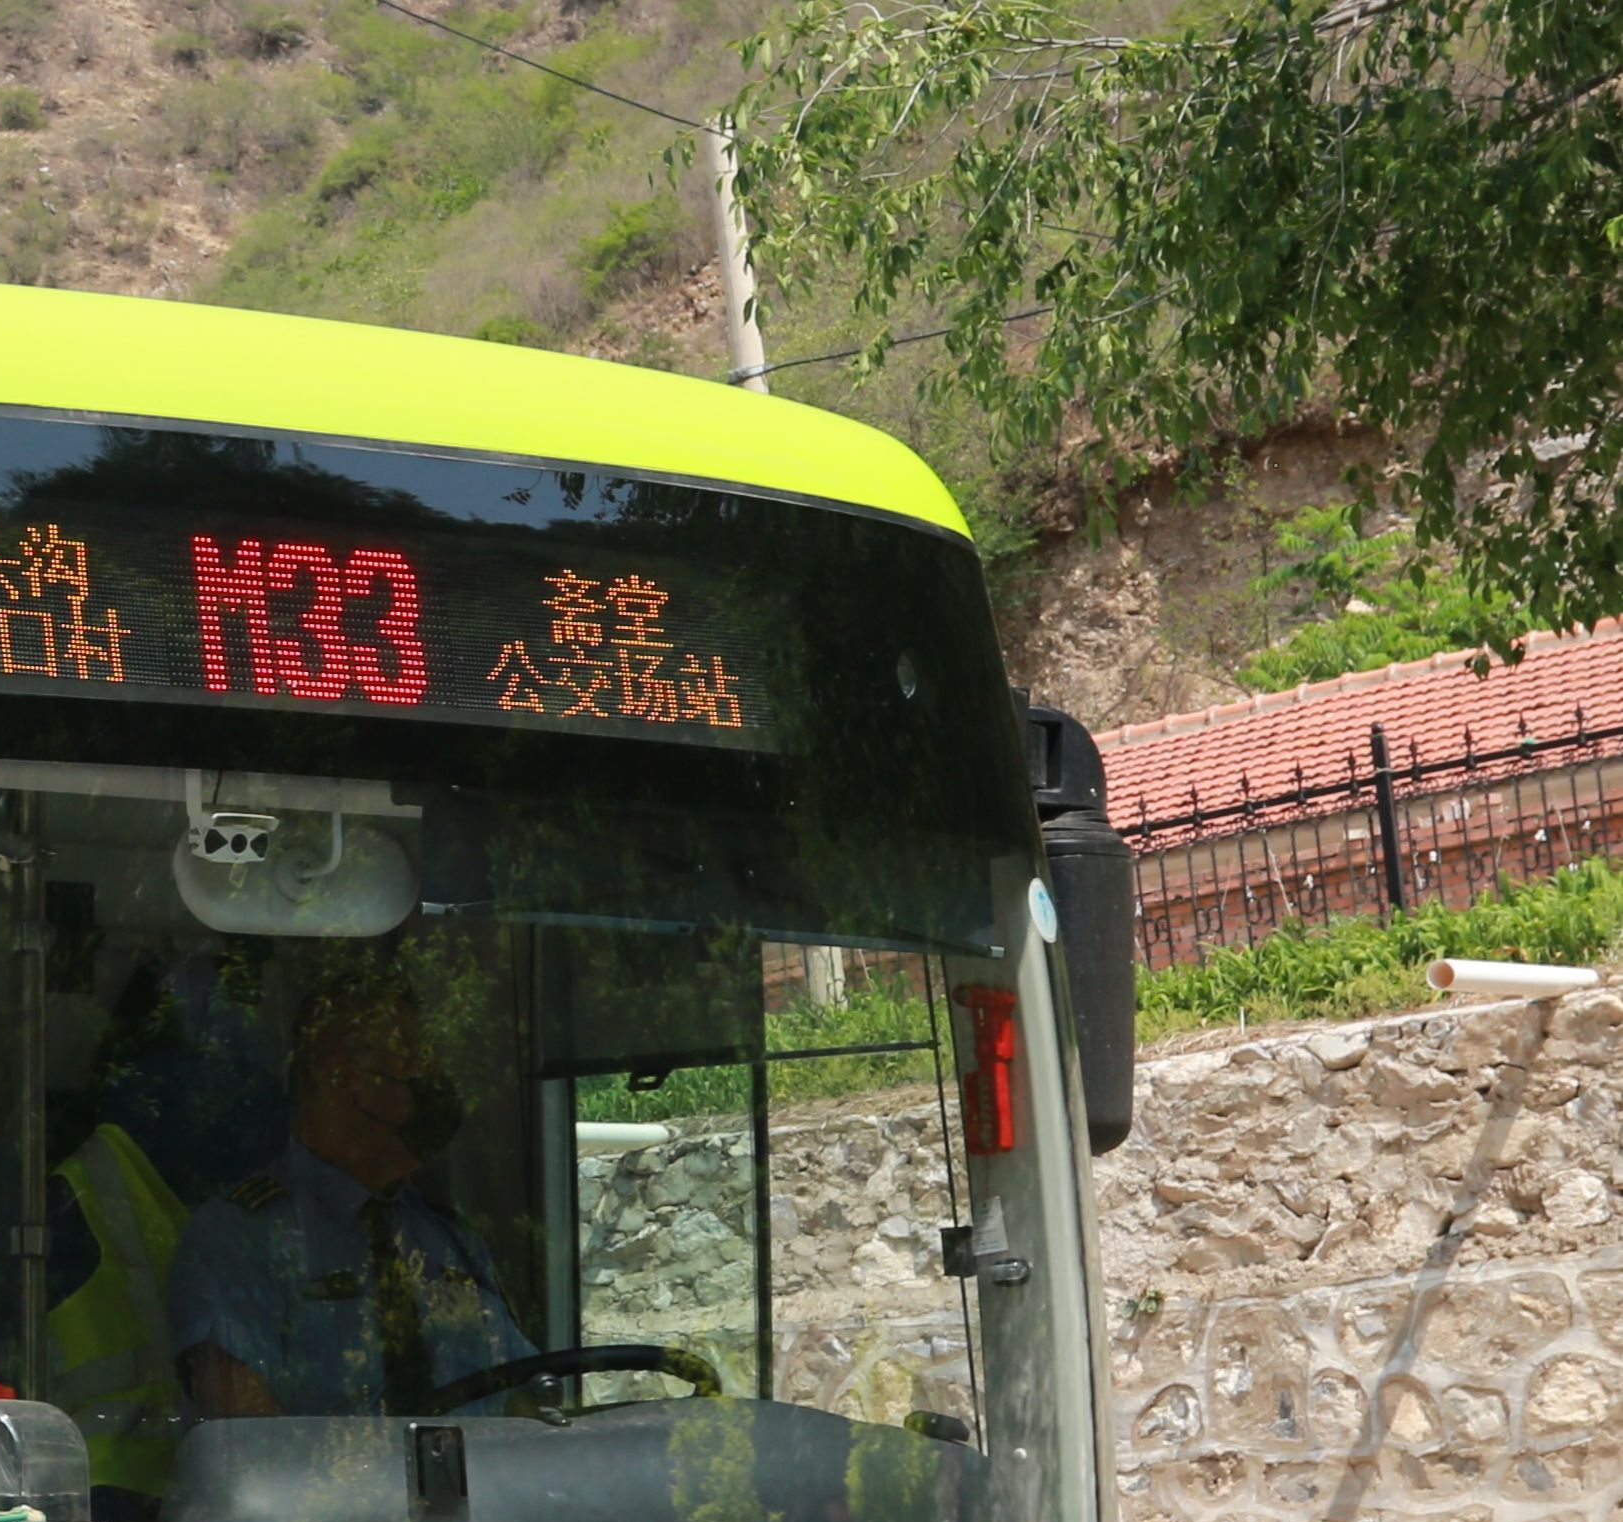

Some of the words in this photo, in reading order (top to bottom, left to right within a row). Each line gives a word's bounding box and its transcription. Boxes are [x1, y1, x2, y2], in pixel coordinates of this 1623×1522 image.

[193, 534, 427, 704] M33
[542, 568, 675, 647] 斋堂
[486, 640, 742, 727] 公交场站
